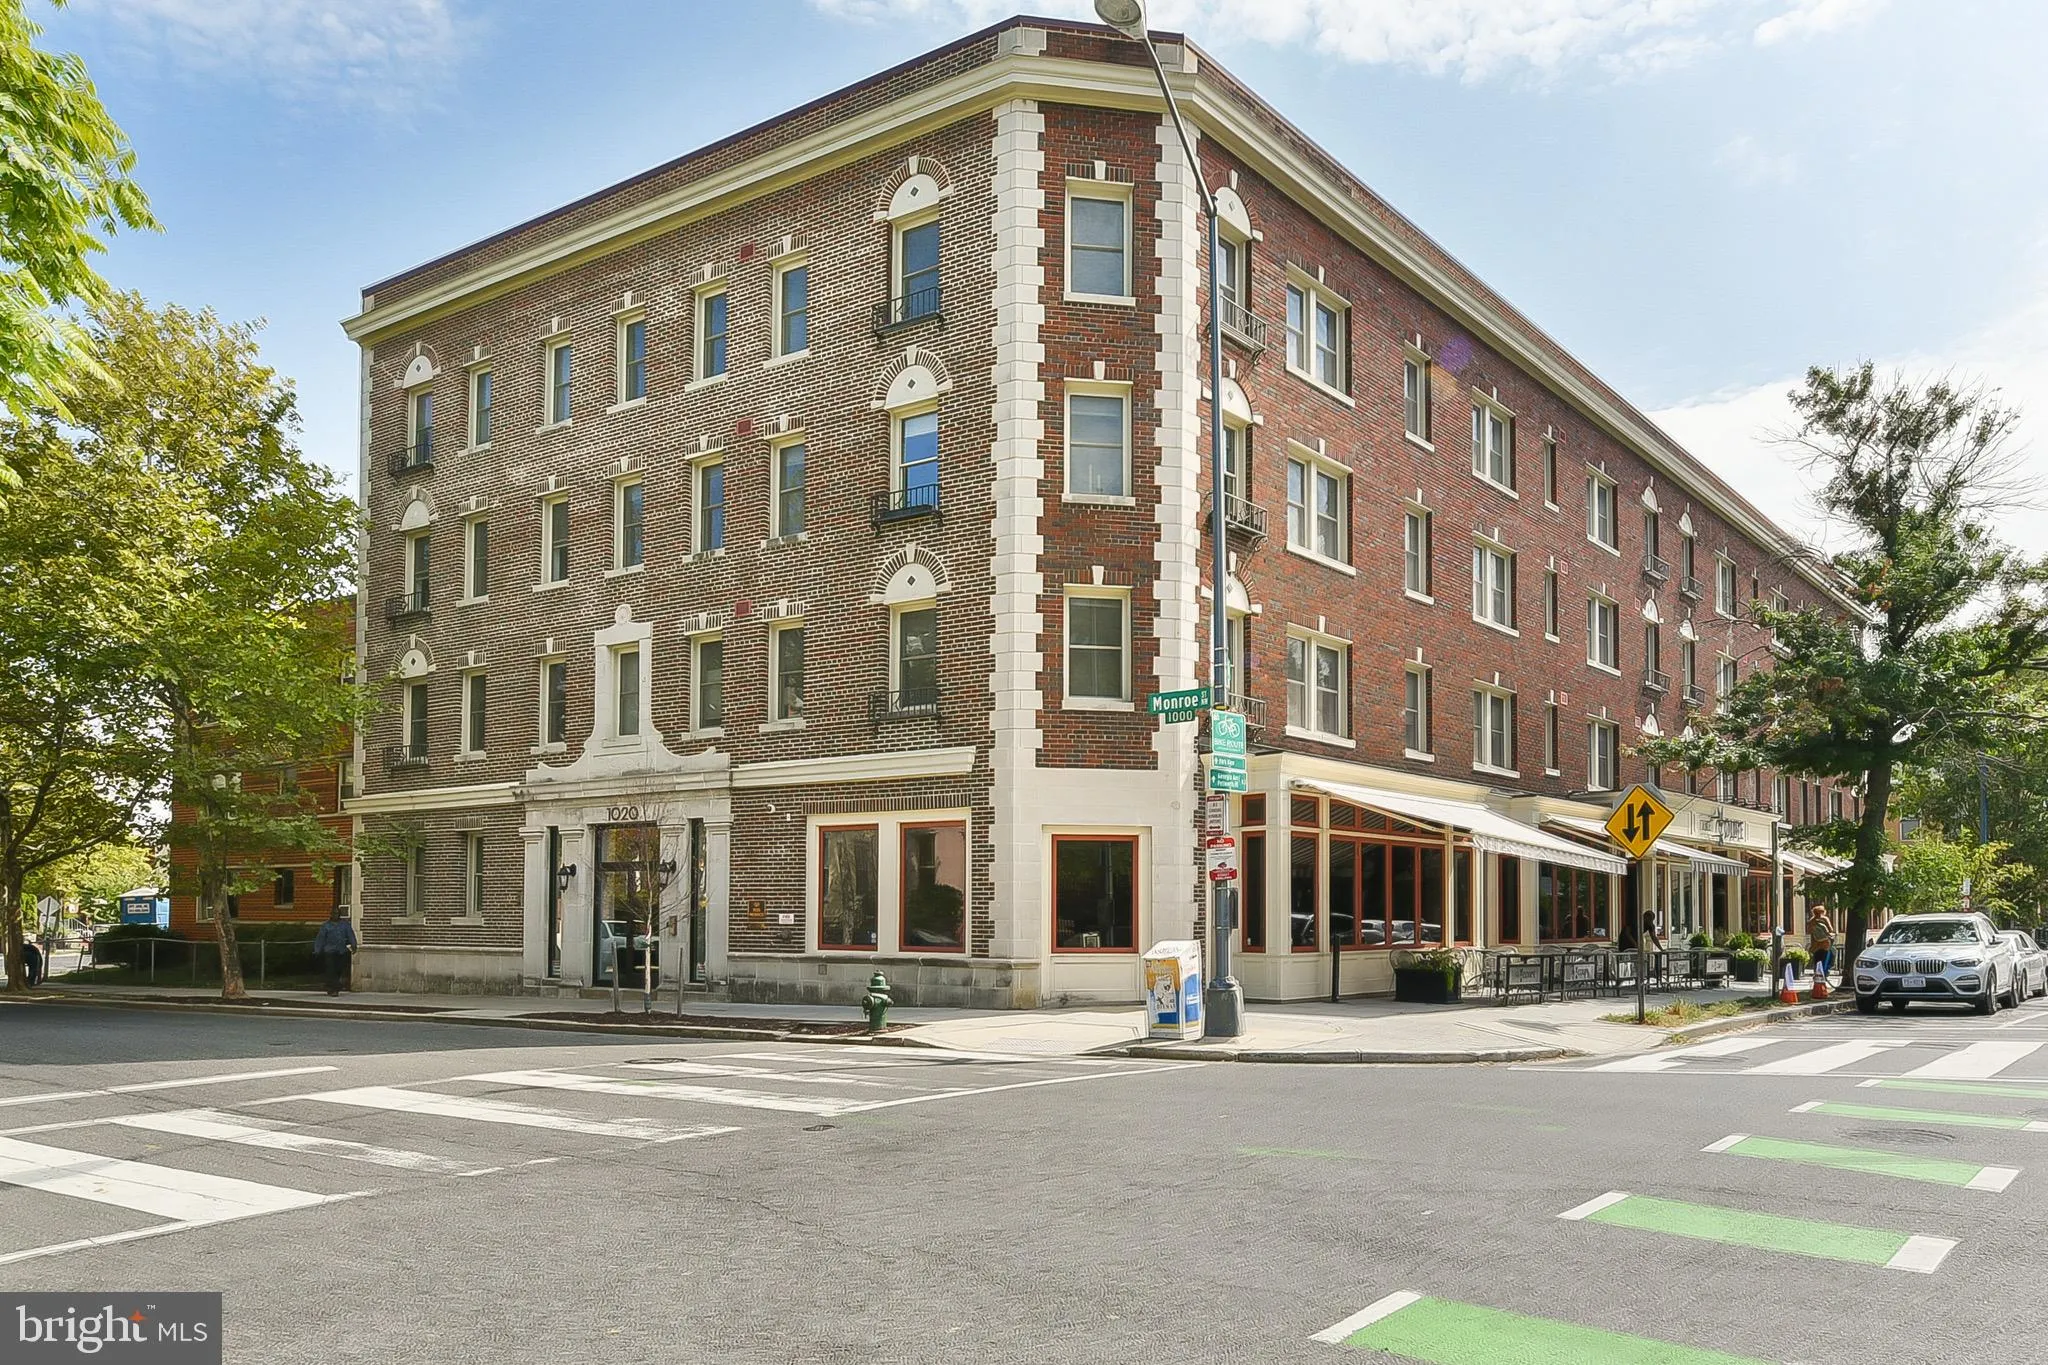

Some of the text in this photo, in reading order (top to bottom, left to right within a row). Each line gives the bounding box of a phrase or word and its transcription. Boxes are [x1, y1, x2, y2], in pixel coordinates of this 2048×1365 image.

[1153, 695, 1199, 711] Monroe
[1168, 711, 1193, 722] 1000
[1214, 738, 1244, 749] BIKE ROUTE
[607, 806, 639, 821] 1020
